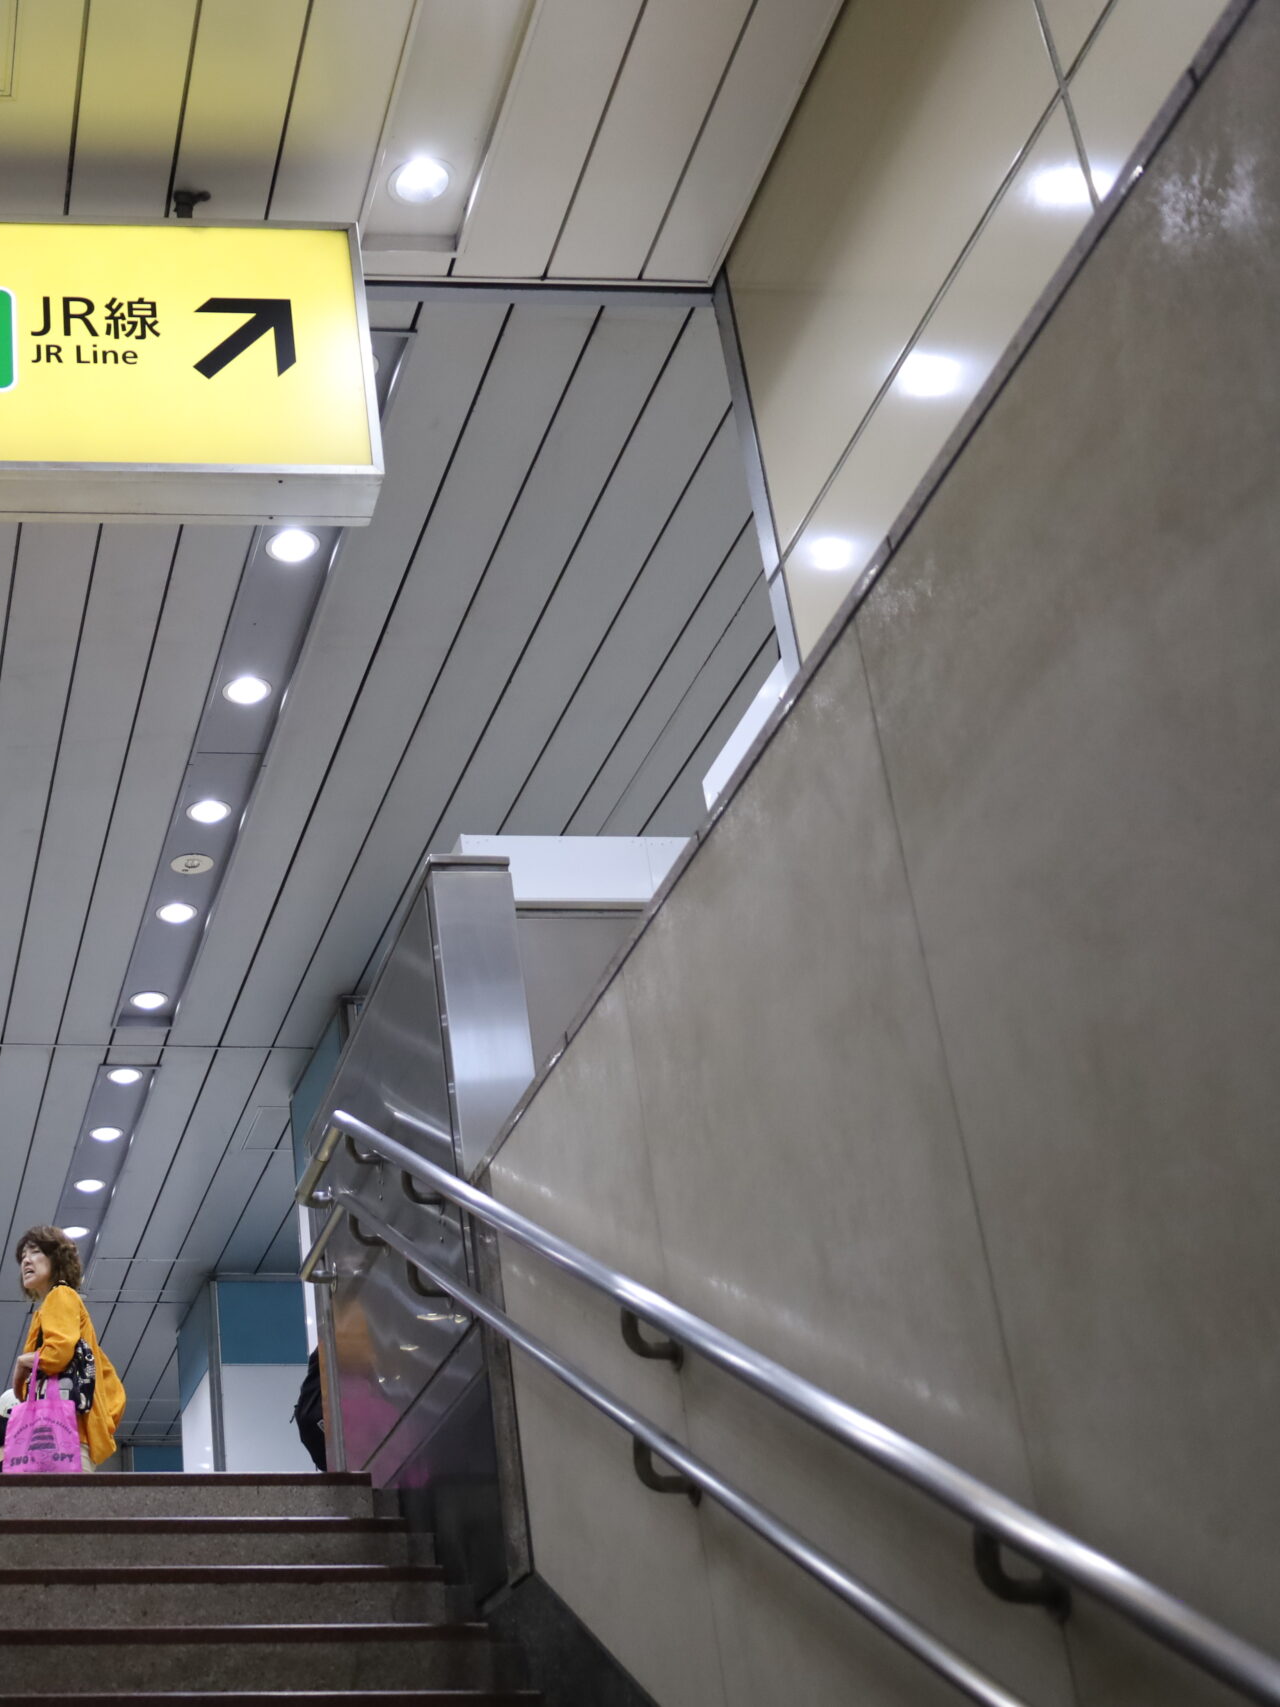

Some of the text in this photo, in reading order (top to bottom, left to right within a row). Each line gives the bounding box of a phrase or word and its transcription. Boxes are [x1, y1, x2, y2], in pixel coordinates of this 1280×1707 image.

[30, 296, 161, 340] JR線
[31, 344, 138, 365] JR Line
